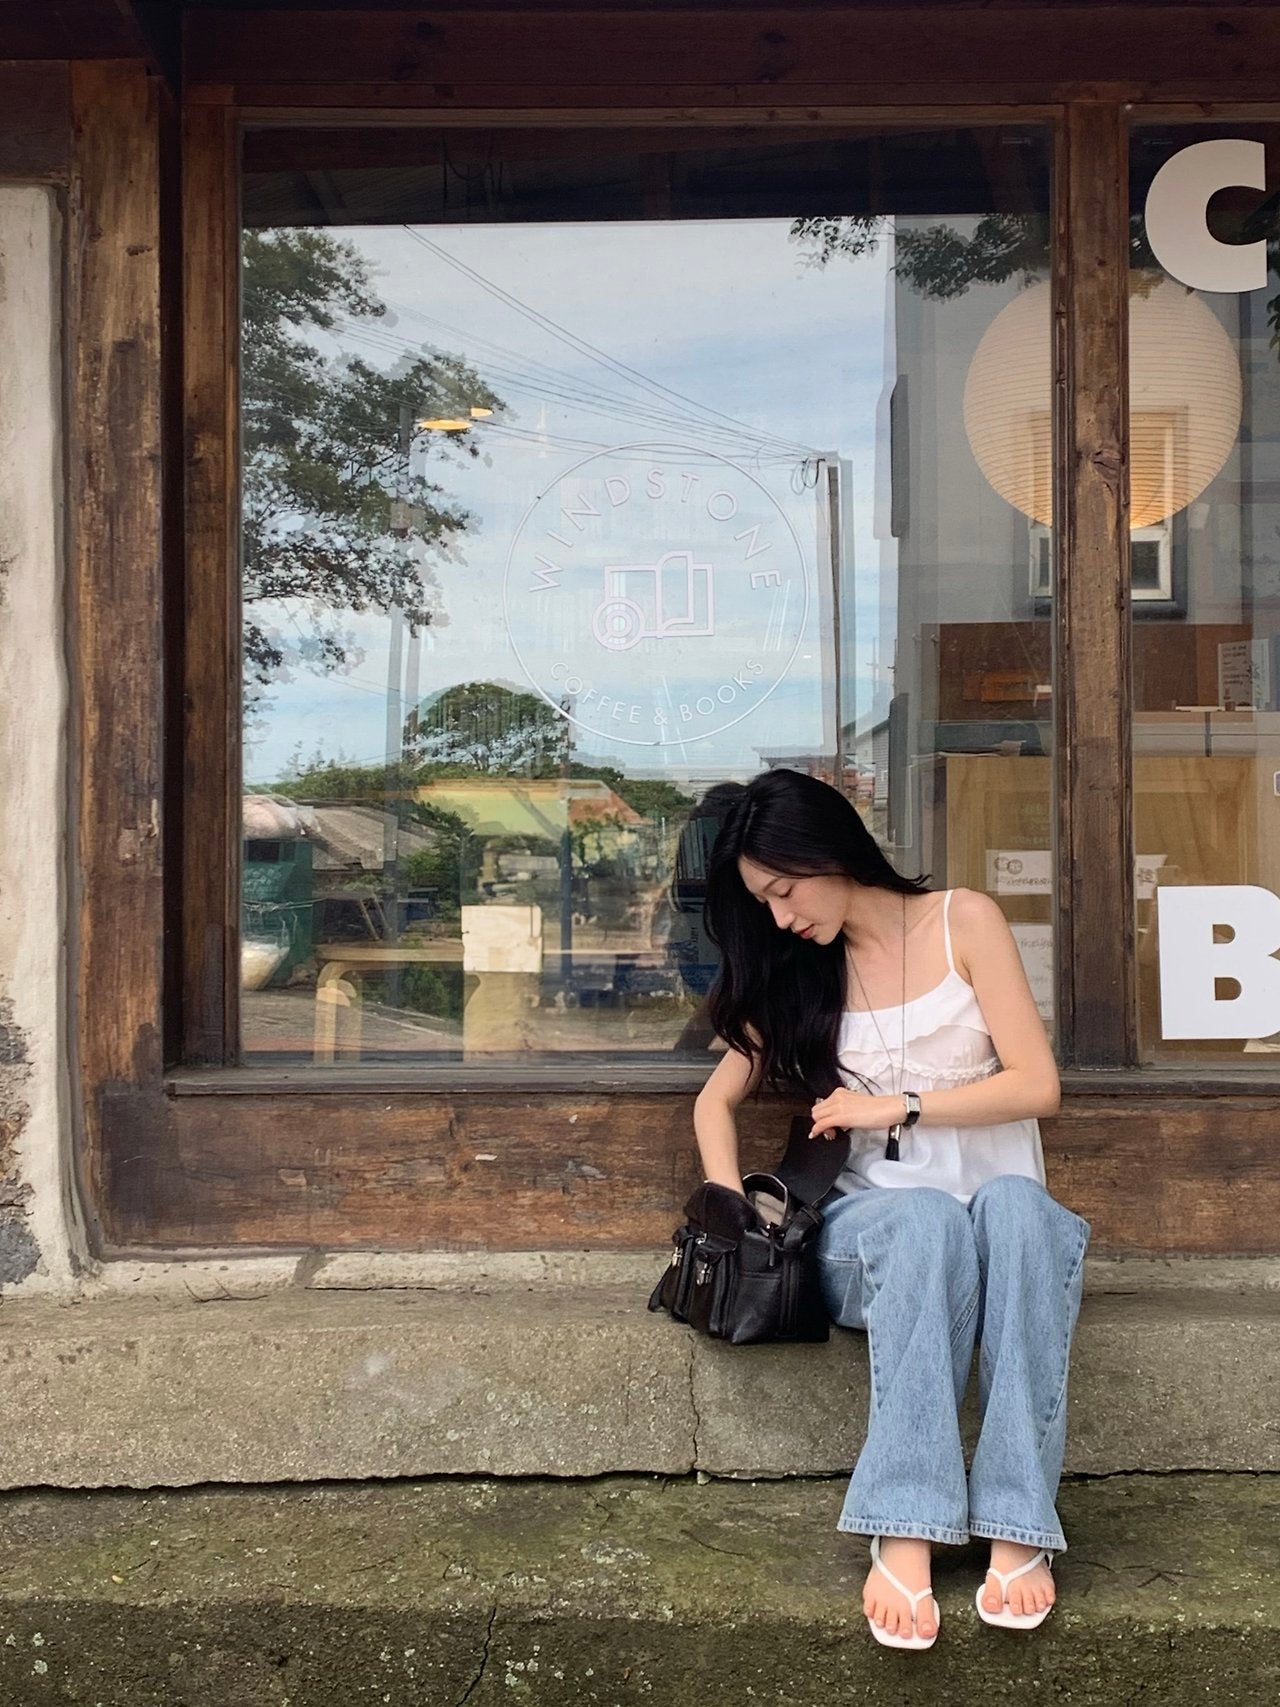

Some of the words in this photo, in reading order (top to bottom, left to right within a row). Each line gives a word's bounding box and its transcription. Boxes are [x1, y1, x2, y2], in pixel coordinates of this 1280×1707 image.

[1145, 138, 1268, 293] C
[529, 467, 782, 593] WINDSTONE
[550, 661, 642, 725] COFFEE
[653, 707, 669, 726] &
[679, 658, 765, 723] BOOKS
[1157, 885, 1280, 1041] B
